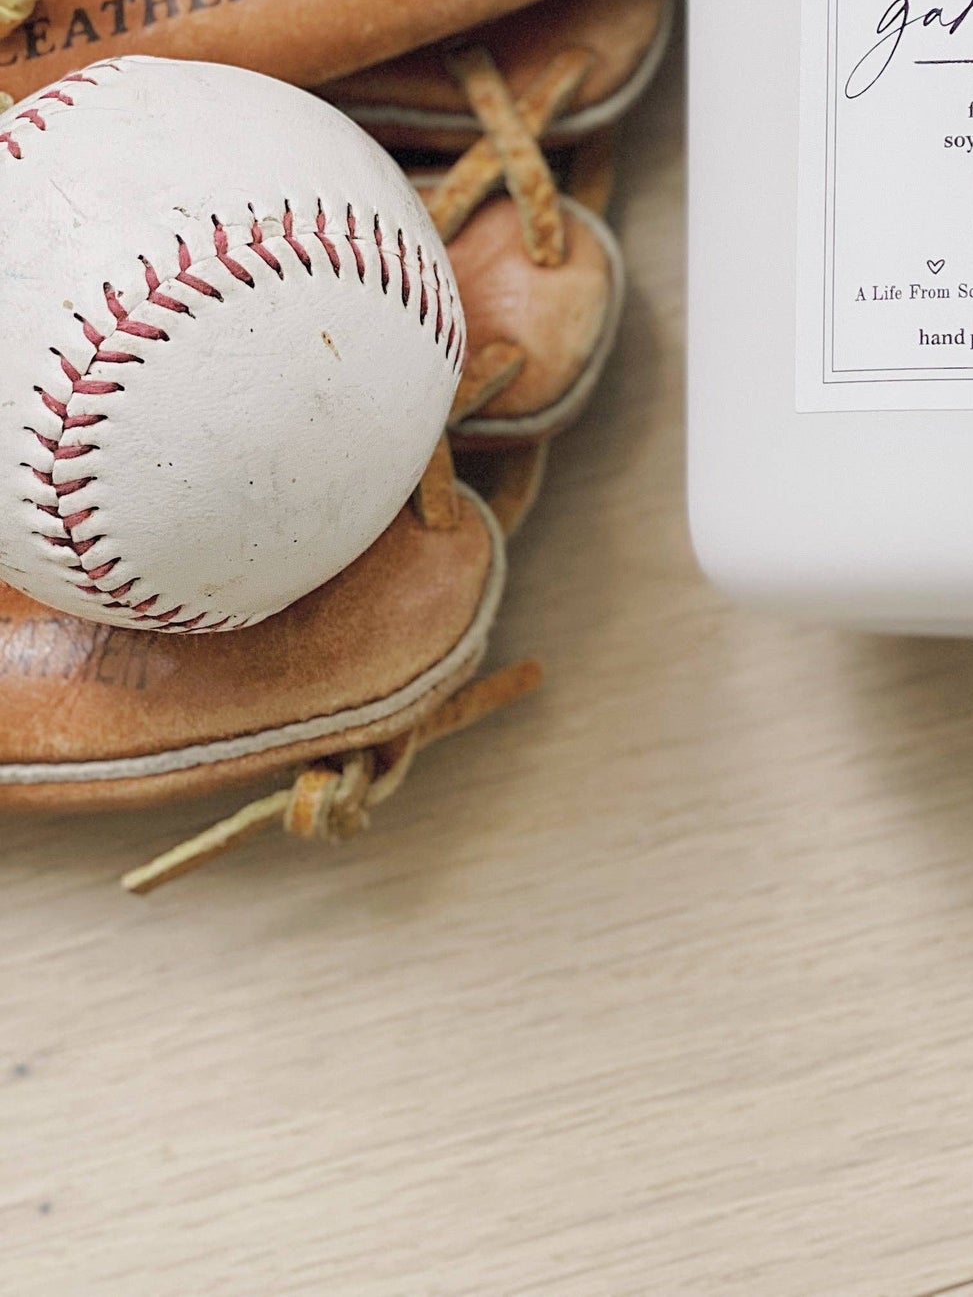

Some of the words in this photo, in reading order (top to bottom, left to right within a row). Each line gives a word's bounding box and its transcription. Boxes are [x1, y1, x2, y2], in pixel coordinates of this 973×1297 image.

[854, 286, 867, 302] A
[872, 285, 903, 301] Life
[908, 283, 951, 300] From
[918, 327, 965, 347] hand
